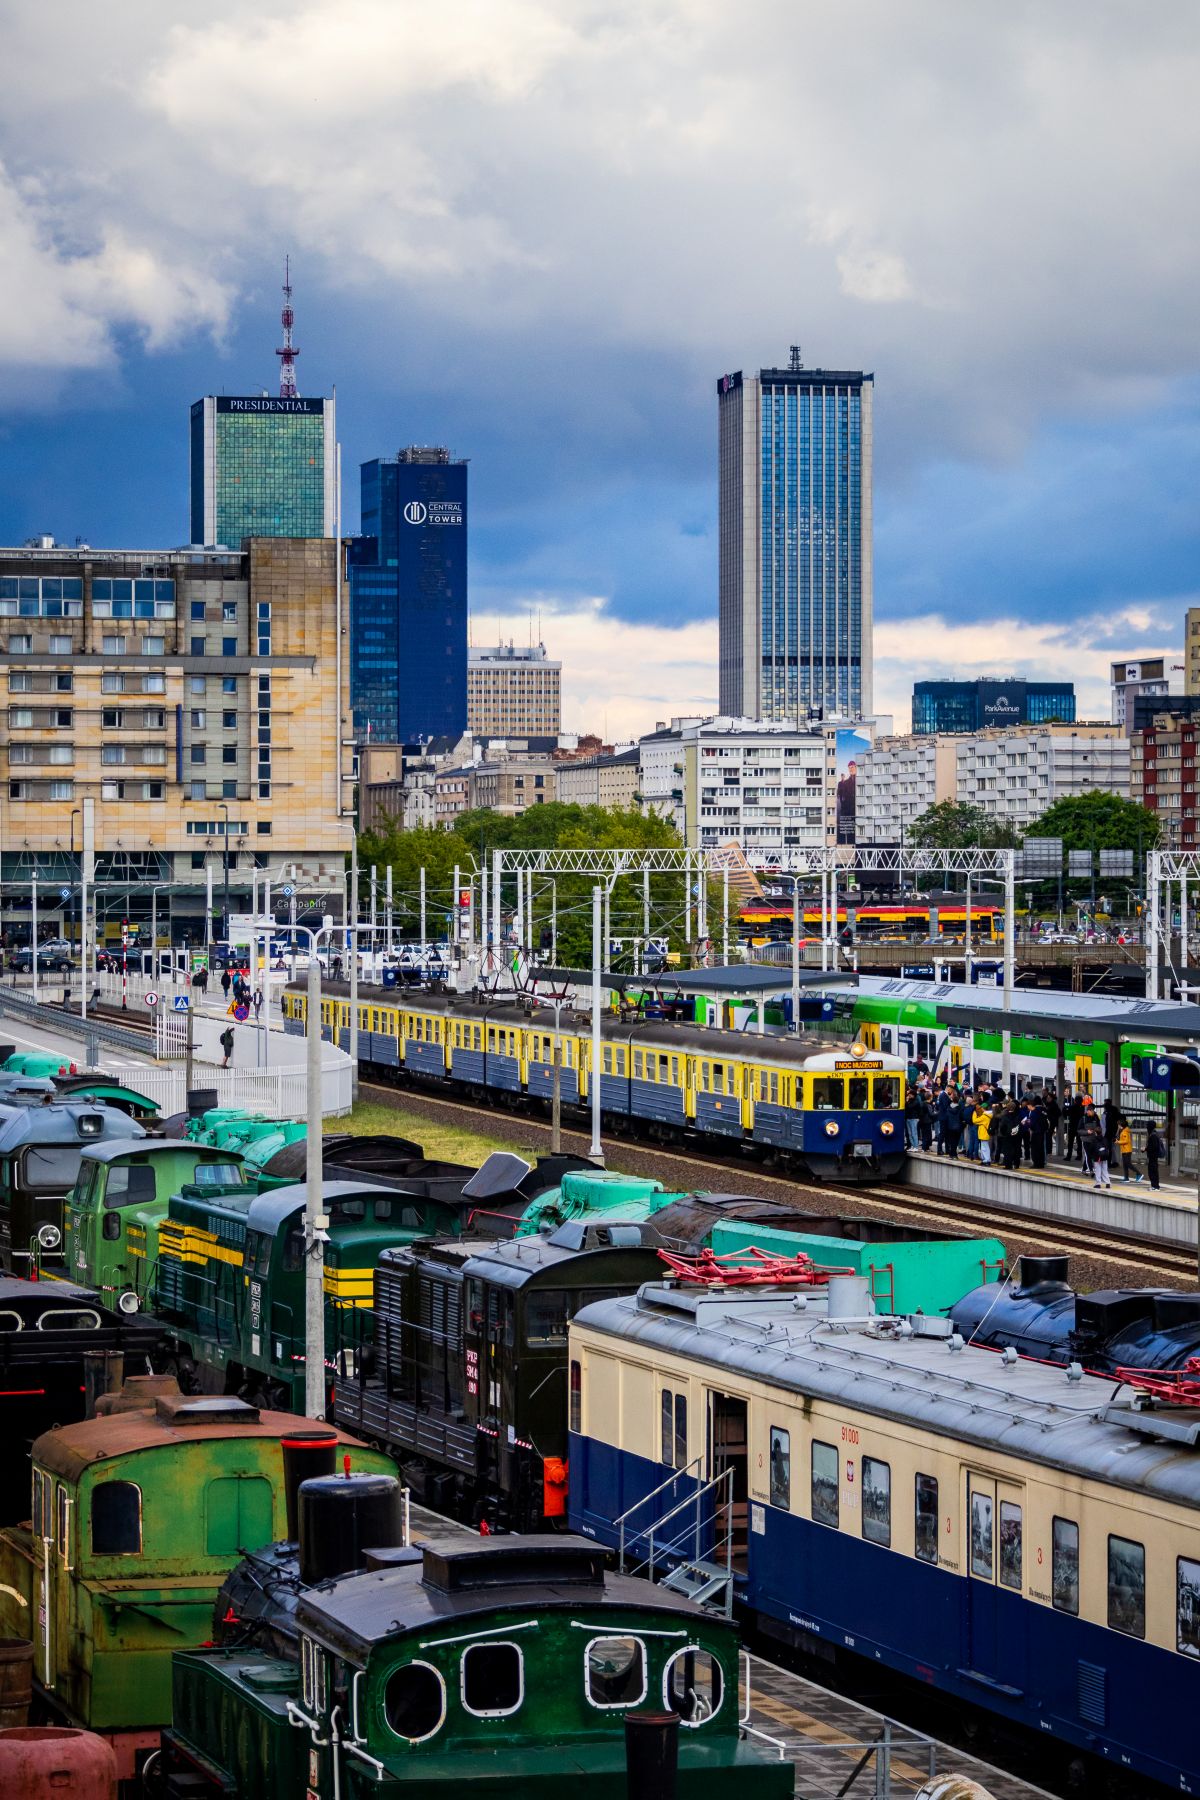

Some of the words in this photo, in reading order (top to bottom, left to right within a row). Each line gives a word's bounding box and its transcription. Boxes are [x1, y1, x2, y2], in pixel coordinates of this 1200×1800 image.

[230, 400, 311, 411] PRESIDENTIAL
[428, 503, 462, 511] CENTRAL
[428, 515, 462, 523] TOWER
[758, 1453, 763, 1468] 3
[946, 1517, 951, 1533] 3
[1037, 1547, 1043, 1565] 3
